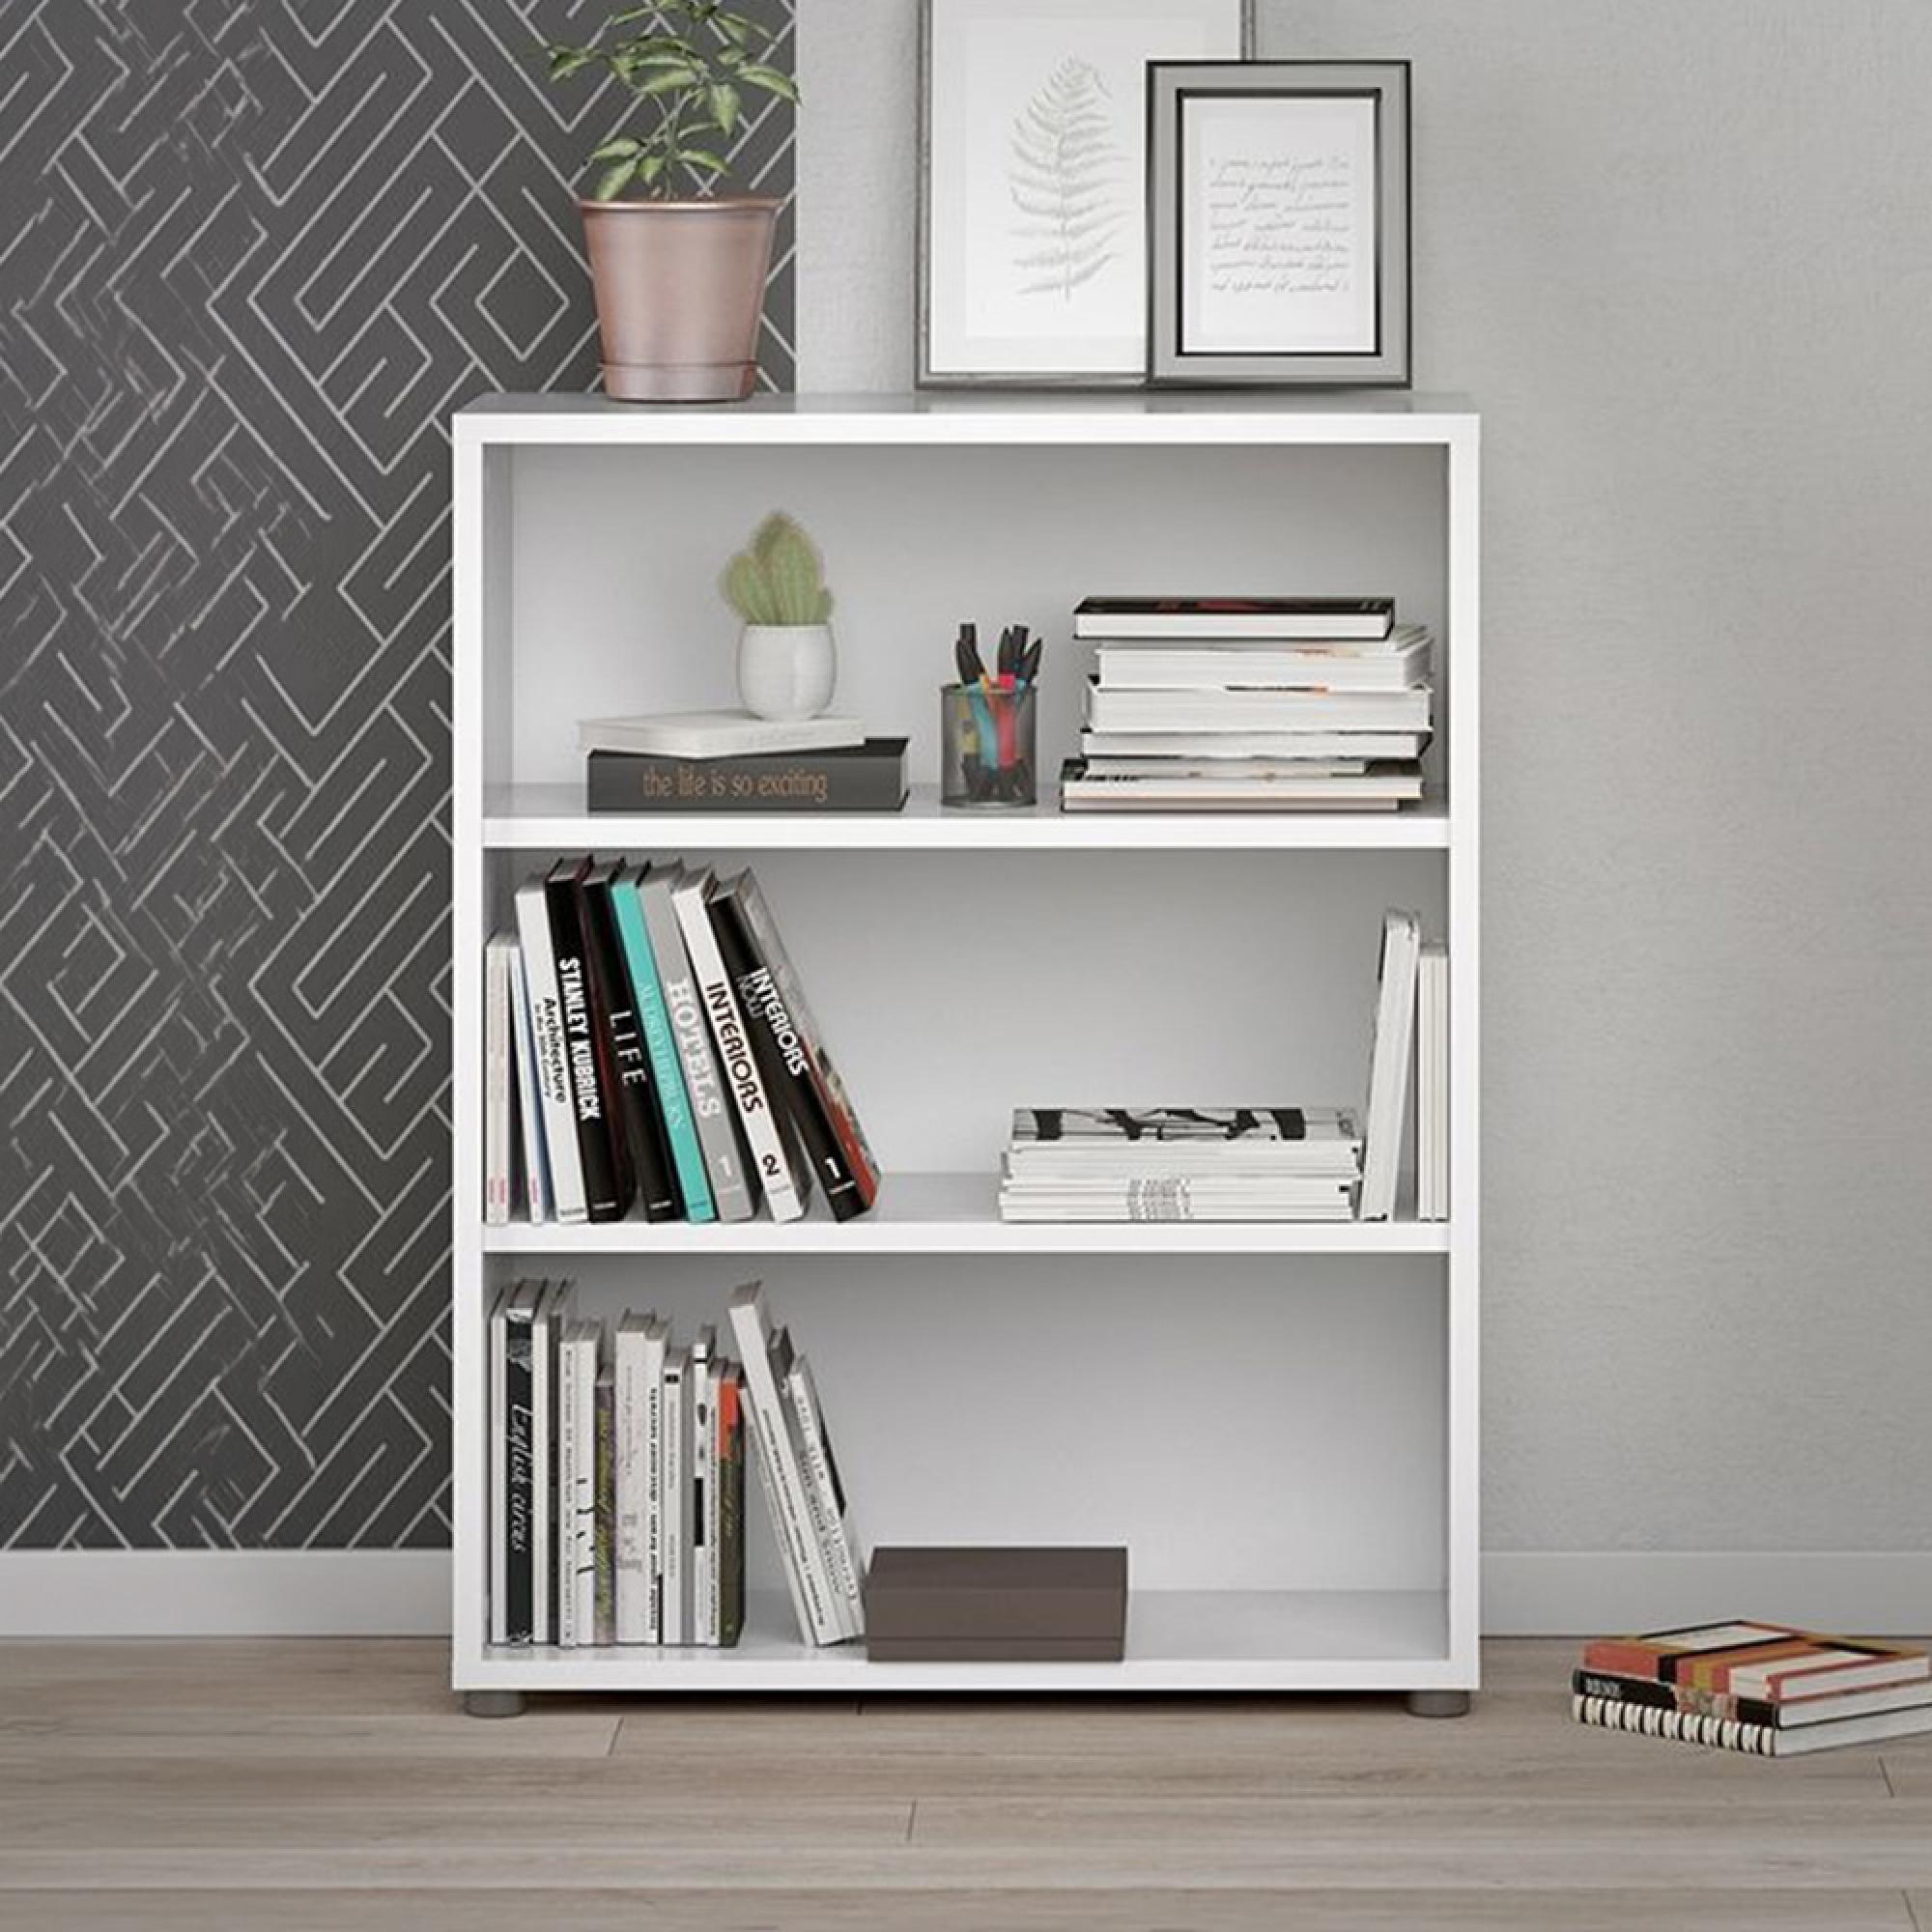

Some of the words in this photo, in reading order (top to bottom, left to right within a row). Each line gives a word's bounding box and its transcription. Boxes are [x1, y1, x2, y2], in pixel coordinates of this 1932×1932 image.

[643, 764, 673, 797] the
[678, 764, 706, 797] life
[711, 768, 726, 797] is
[731, 773, 753, 797] so
[757, 765, 828, 804] exciting
[559, 957, 589, 1034] STANLEY
[750, 967, 810, 1076] INTERIORS
[543, 996, 566, 1104] Architecture
[570, 1039, 602, 1121] KUBRICK
[610, 1010, 646, 1087] LIFE
[667, 978, 720, 1118] HOTELS
[706, 981, 764, 1113] INTERIORS
[762, 1153, 781, 1177] 2
